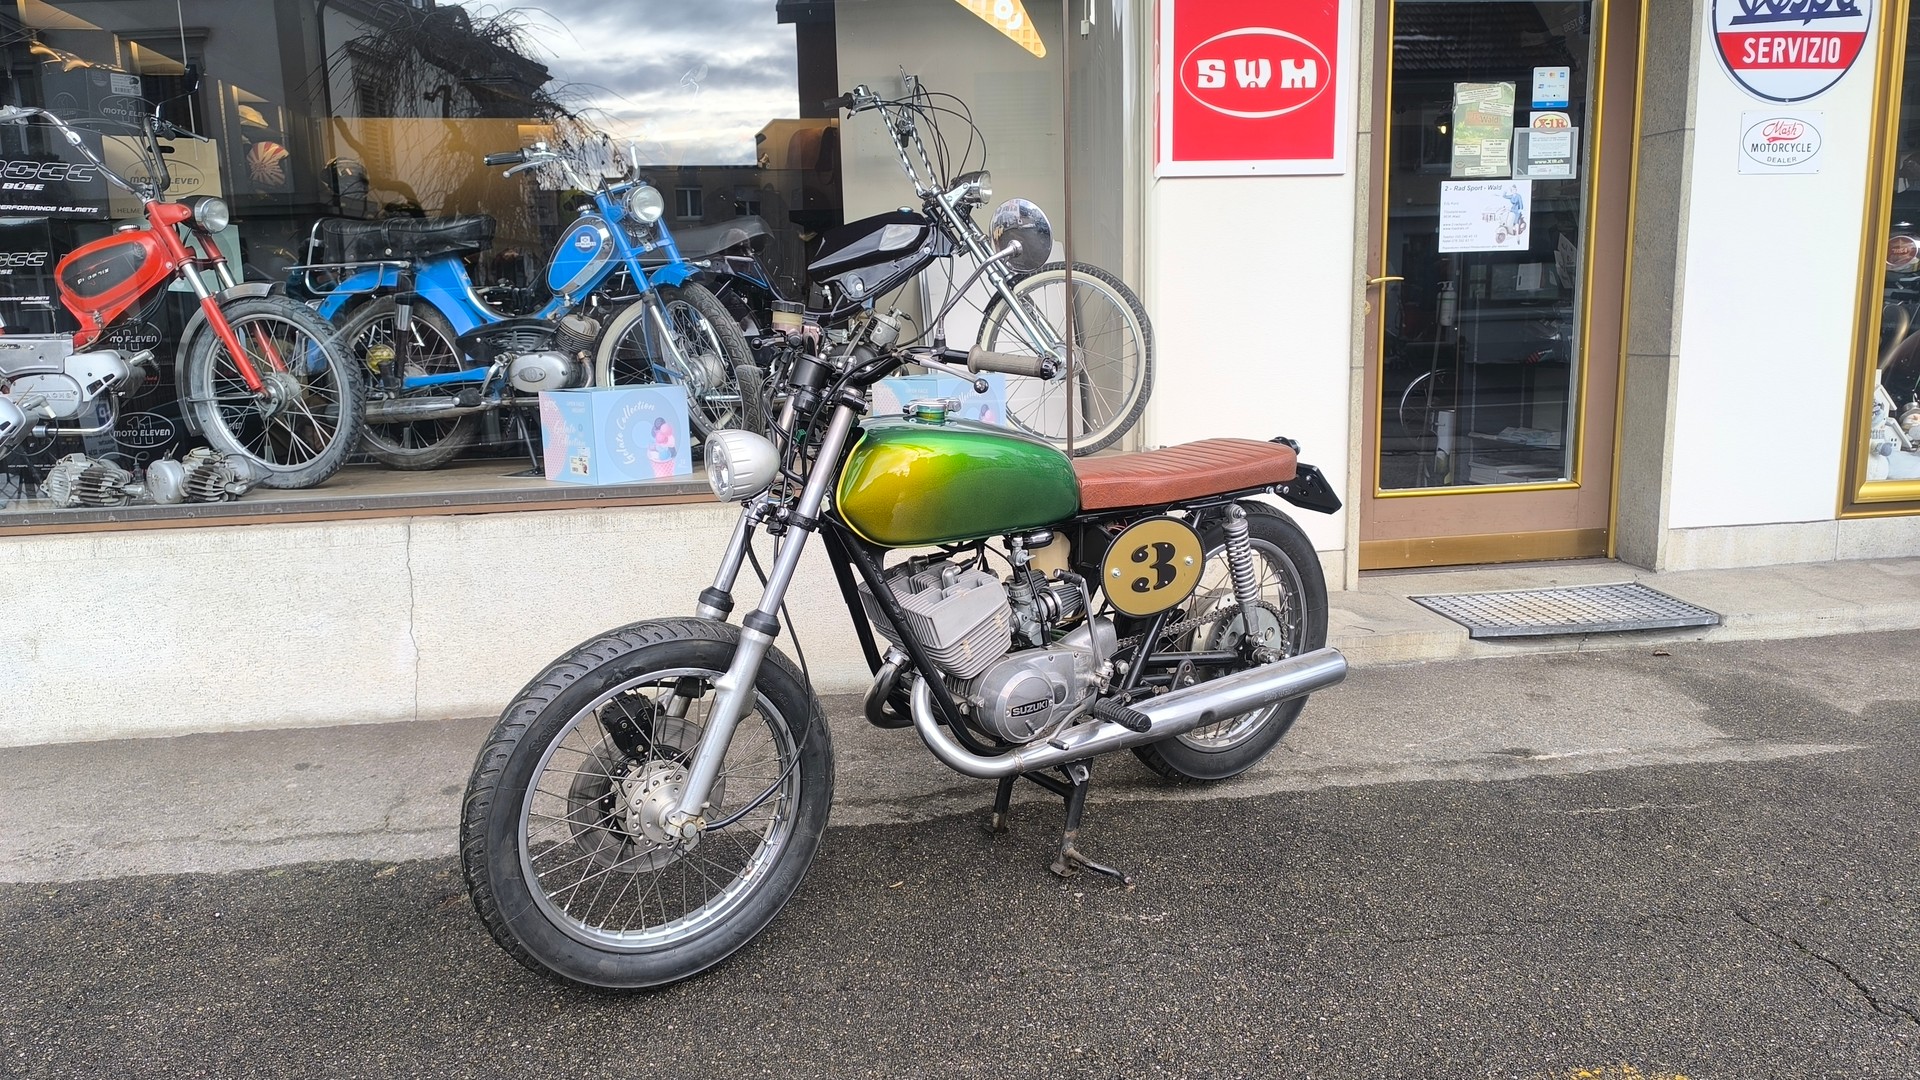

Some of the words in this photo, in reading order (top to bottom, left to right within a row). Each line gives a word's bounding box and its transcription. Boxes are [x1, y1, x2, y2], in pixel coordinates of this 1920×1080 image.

[1742, 37, 1841, 64] SERVIZIO
[1197, 58, 1319, 89] SWM
[103, 107, 127, 115] MOTO
[1763, 121, 1798, 136] Mash
[1750, 143, 1812, 153] MOTORCYCLE
[0, 160, 98, 182] OCC
[2, 181, 45, 191] BÜSE
[616, 401, 655, 430] Collection
[140, 428, 170, 436] ELEVEN
[615, 432, 636, 465] Gelato
[1131, 542, 1177, 593] 3
[1012, 700, 1048, 716] SUZUKI
